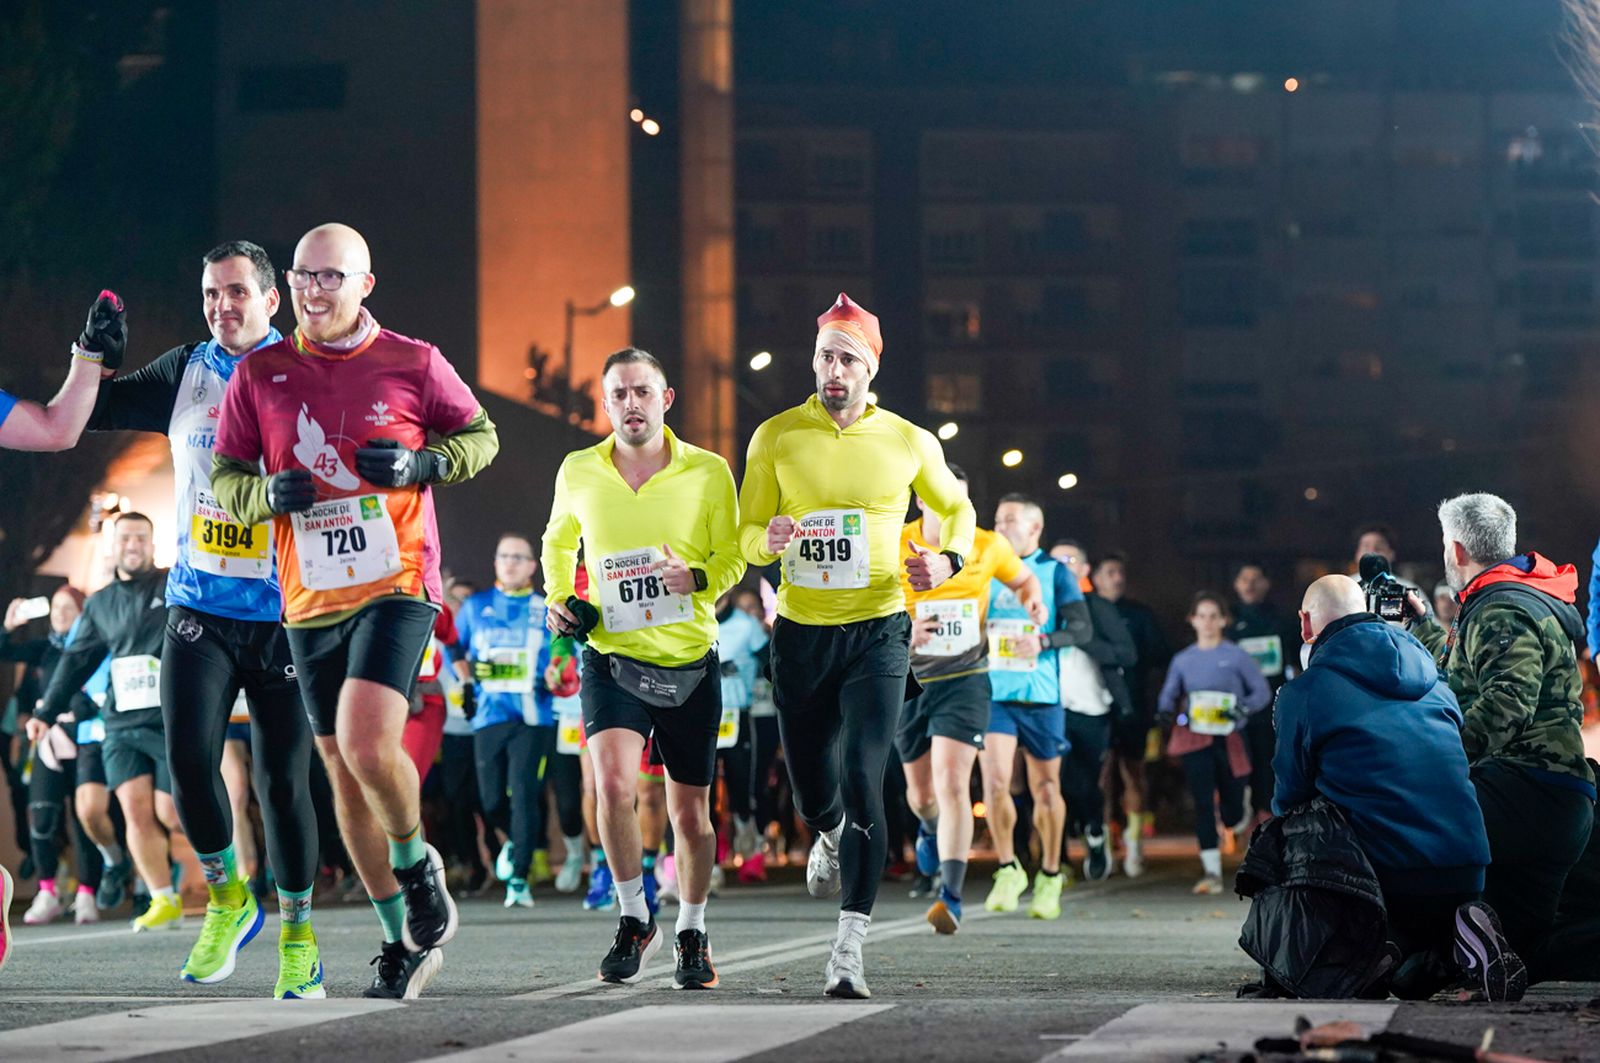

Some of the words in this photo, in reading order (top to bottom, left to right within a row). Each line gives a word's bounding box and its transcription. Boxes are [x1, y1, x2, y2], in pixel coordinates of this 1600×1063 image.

[313, 452, 338, 478] 43
[197, 506, 211, 517] SAN
[312, 504, 338, 518] NOCHE
[340, 503, 351, 515] DE
[304, 519, 321, 532] SAN
[323, 514, 353, 528] ANTÓN
[801, 518, 823, 528] OCHE
[825, 518, 835, 527] DE
[203, 519, 253, 550] 3194
[807, 526, 835, 538] ANTÓN
[321, 525, 367, 557] 720
[800, 538, 851, 562] 4319
[615, 557, 640, 569] NOCHE
[641, 555, 651, 566] DE
[607, 570, 623, 581] SAN
